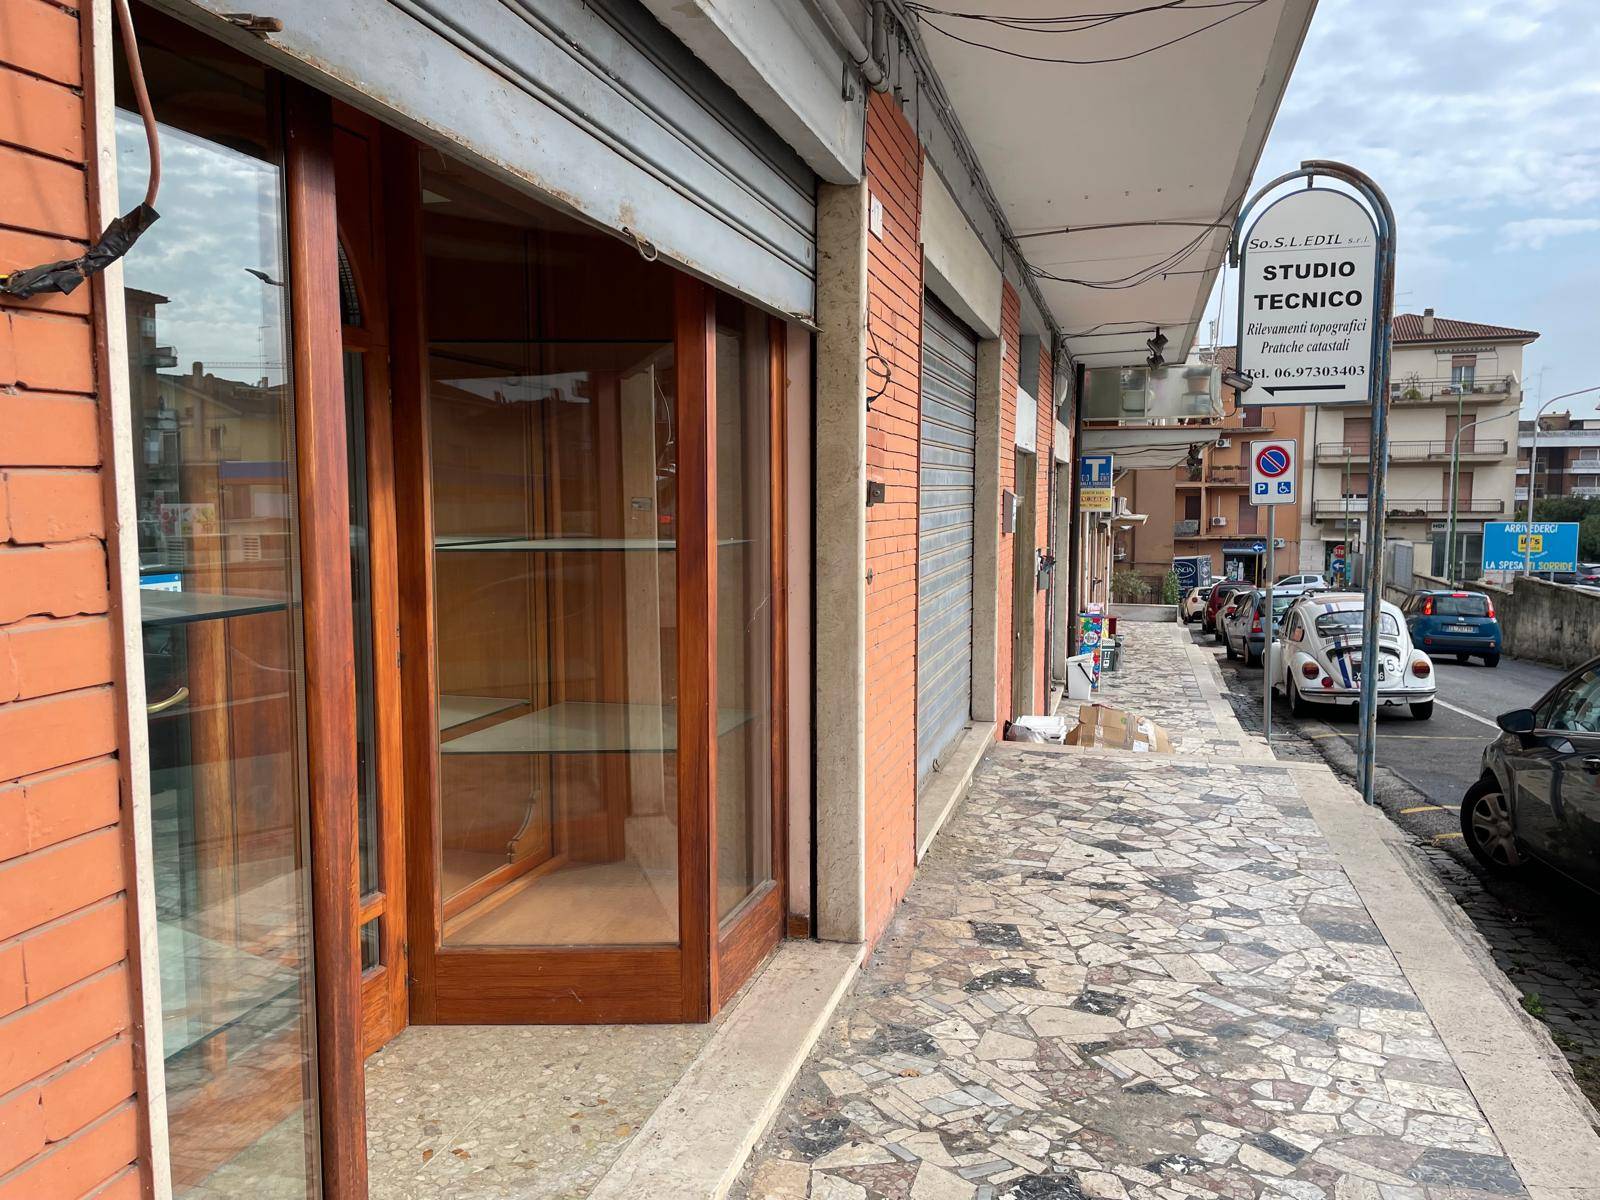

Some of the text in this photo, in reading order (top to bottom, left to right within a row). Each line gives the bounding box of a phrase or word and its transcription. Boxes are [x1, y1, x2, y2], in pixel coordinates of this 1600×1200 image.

[1262, 261, 1356, 281] STUDIO
[1254, 290, 1363, 310] TECNICO
[1247, 318, 1368, 336] Rilevamenti topografici
[1260, 338, 1350, 354] Pratiche catastali
[1244, 365, 1365, 379] Tel. 06.97303403
[1085, 458, 1106, 482] T
[1257, 483, 1266, 494] P
[1485, 561, 1496, 570] LA
[1498, 561, 1524, 570] SPESA
[1538, 561, 1574, 571] SORRIDE
